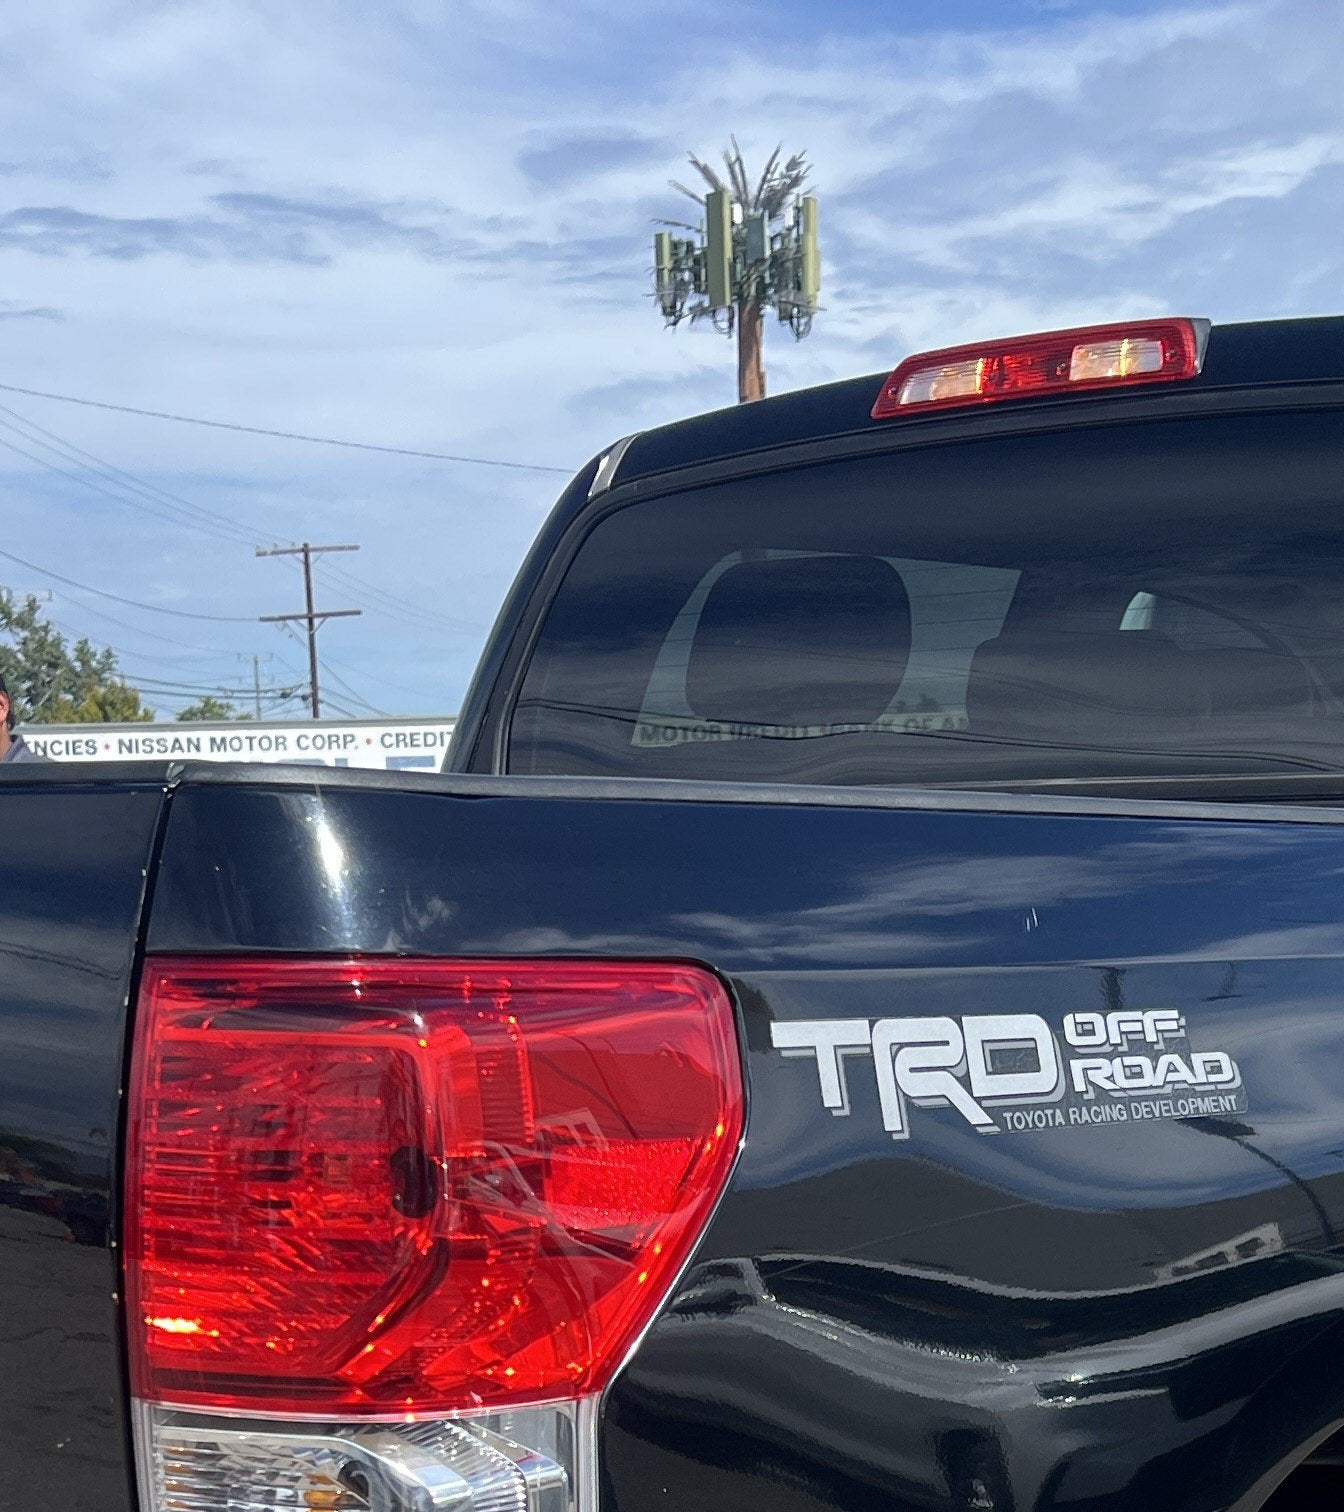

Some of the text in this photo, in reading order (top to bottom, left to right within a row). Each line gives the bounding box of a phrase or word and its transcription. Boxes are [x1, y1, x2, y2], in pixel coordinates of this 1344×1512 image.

[117, 736, 202, 754] NISSAN
[209, 735, 287, 752] MOTOR
[296, 734, 359, 751] CORP.
[1062, 1009, 1184, 1050] OFF
[770, 1013, 1062, 1136] TRD
[1069, 1050, 1240, 1095] ROAD
[1002, 1095, 1238, 1131] TOYOTA RACING DEVELOPMENT
